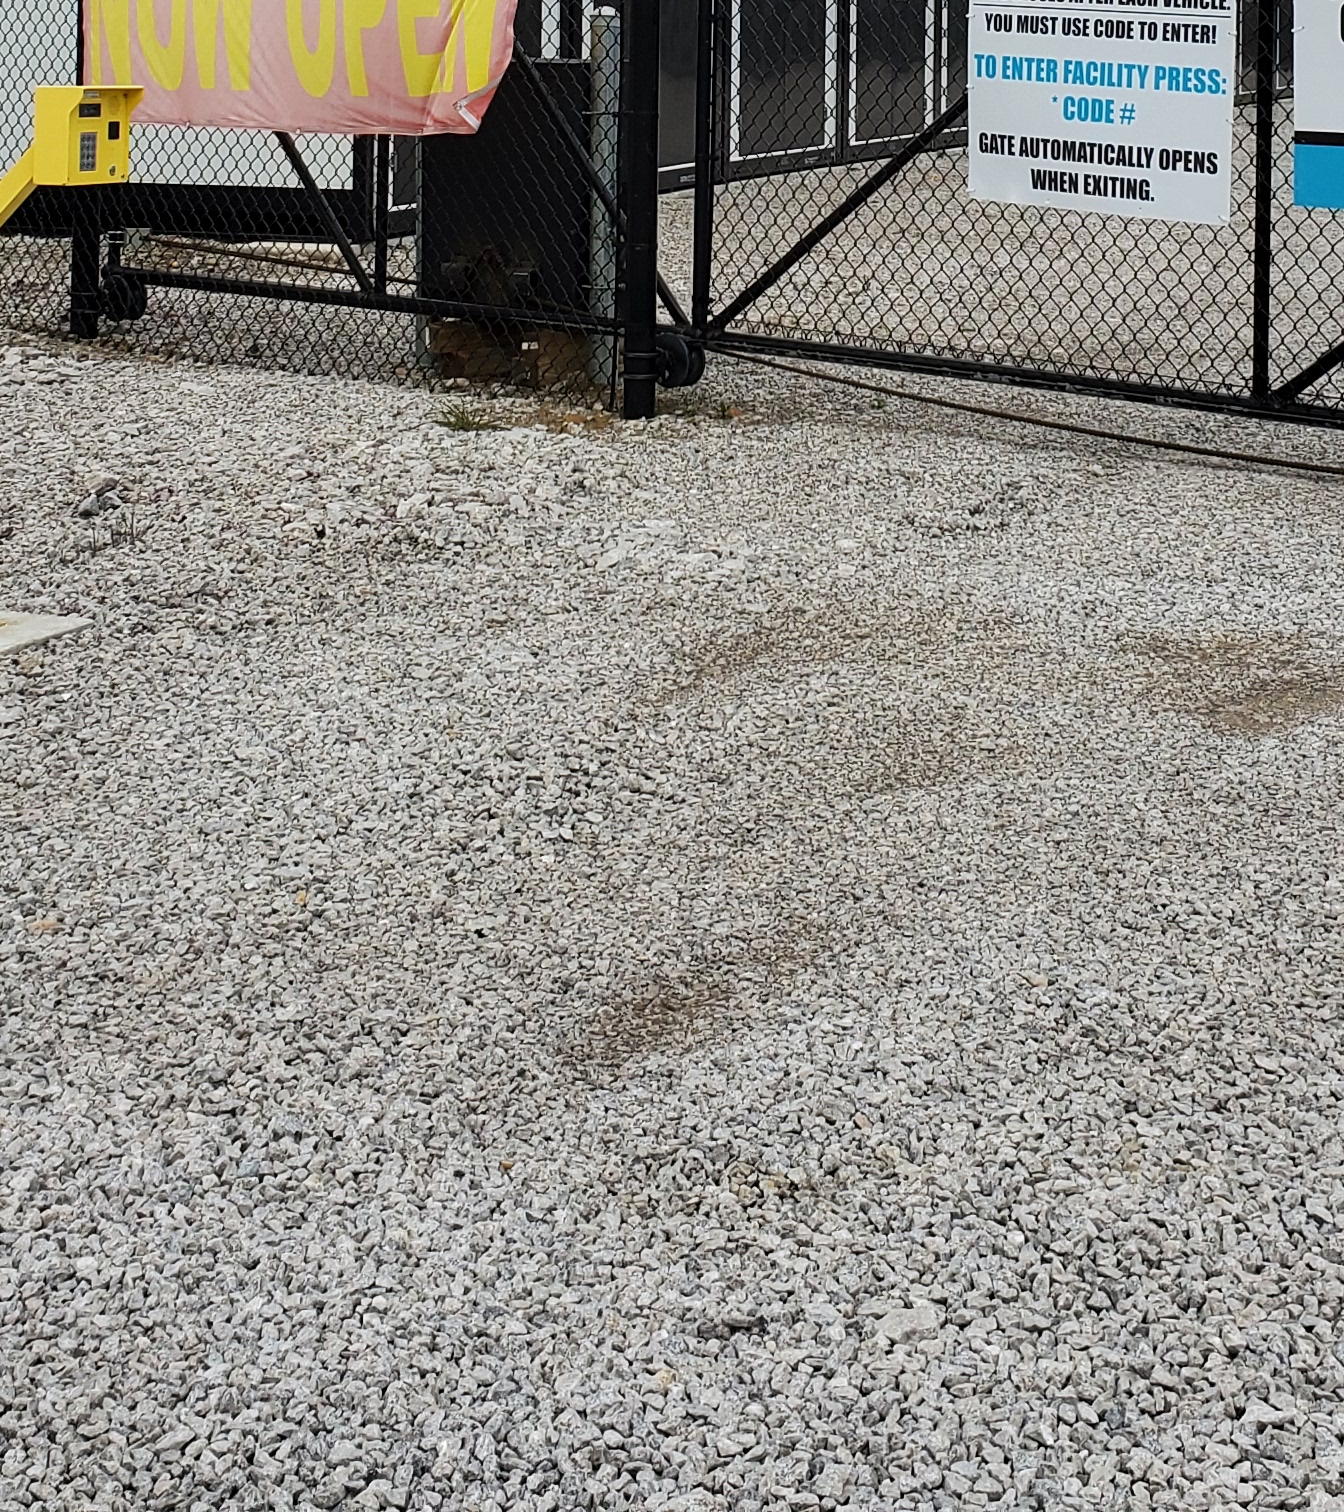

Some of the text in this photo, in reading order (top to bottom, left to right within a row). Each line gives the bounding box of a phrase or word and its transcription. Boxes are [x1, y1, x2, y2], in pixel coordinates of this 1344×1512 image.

[985, 13, 1217, 44] YOU MUST USE CODE TO ENTER!
[974, 54, 1227, 95] TO ENTER FACILITY PRESS:
[1063, 96, 1114, 124] CODE
[1119, 103, 1136, 125] #
[979, 132, 1218, 174] GATE AUTOMATICALLY OPENS
[1031, 169, 1155, 202] WHEN EXITING.
